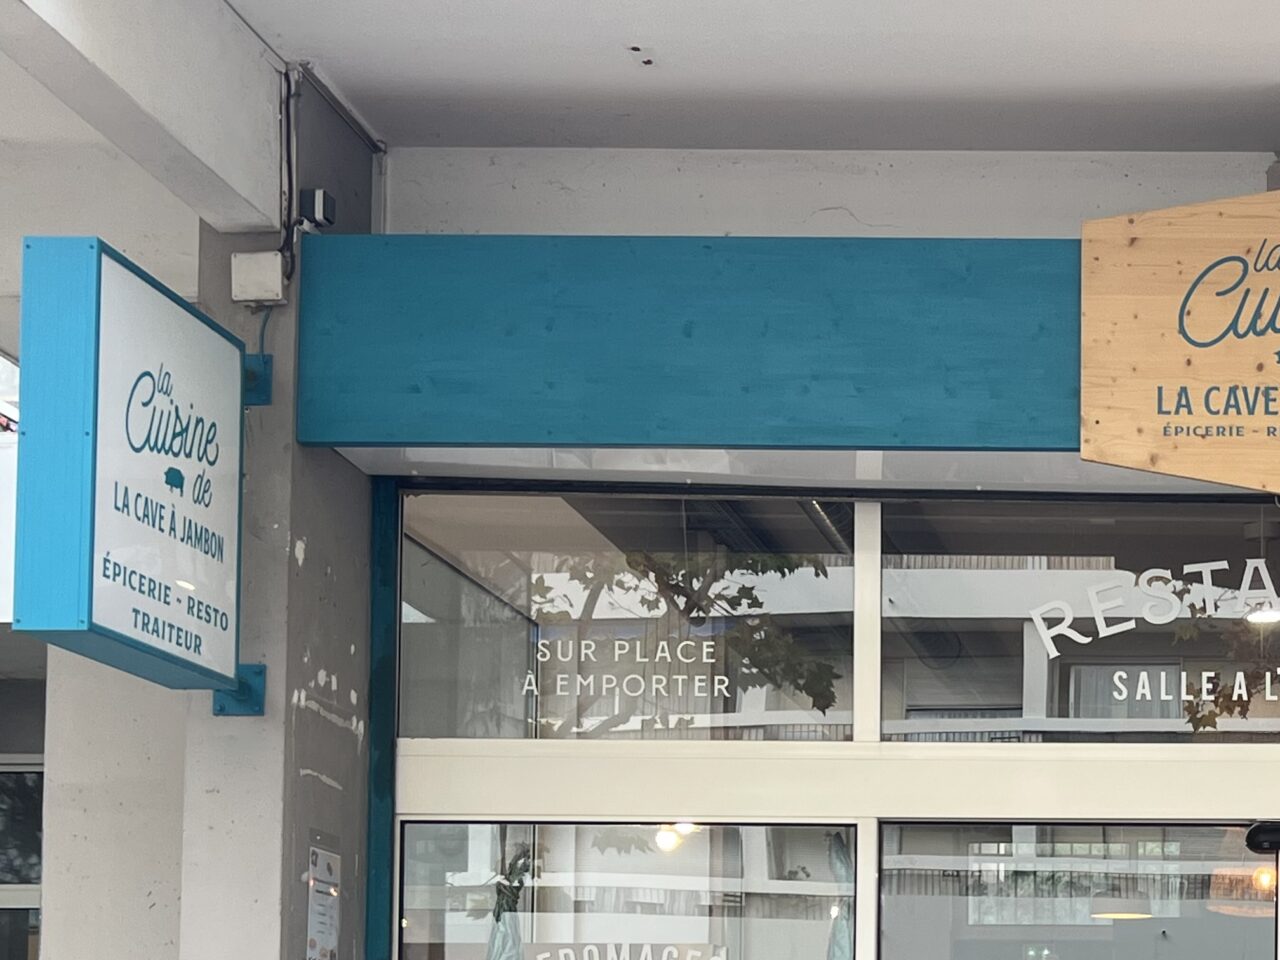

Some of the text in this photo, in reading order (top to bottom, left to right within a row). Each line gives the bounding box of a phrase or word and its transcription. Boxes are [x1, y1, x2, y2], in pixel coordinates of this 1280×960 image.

[157, 362, 173, 398] la
[125, 370, 219, 467] Cuisine
[1157, 386, 1193, 416] LA
[1204, 386, 1279, 416] CAVE
[1163, 422, 1245, 437] ÉPICERIE
[192, 468, 213, 508] de
[113, 481, 225, 564] LA CAVE À JAMBON
[102, 551, 171, 606] ÉPICERIE
[187, 595, 229, 631] RESTO
[132, 607, 203, 655] TRAITEUR
[537, 640, 716, 663] SUR PLACE
[521, 670, 731, 697] À EMPORTER
[1112, 671, 1216, 701] SALLE
[1232, 671, 1249, 701] A
